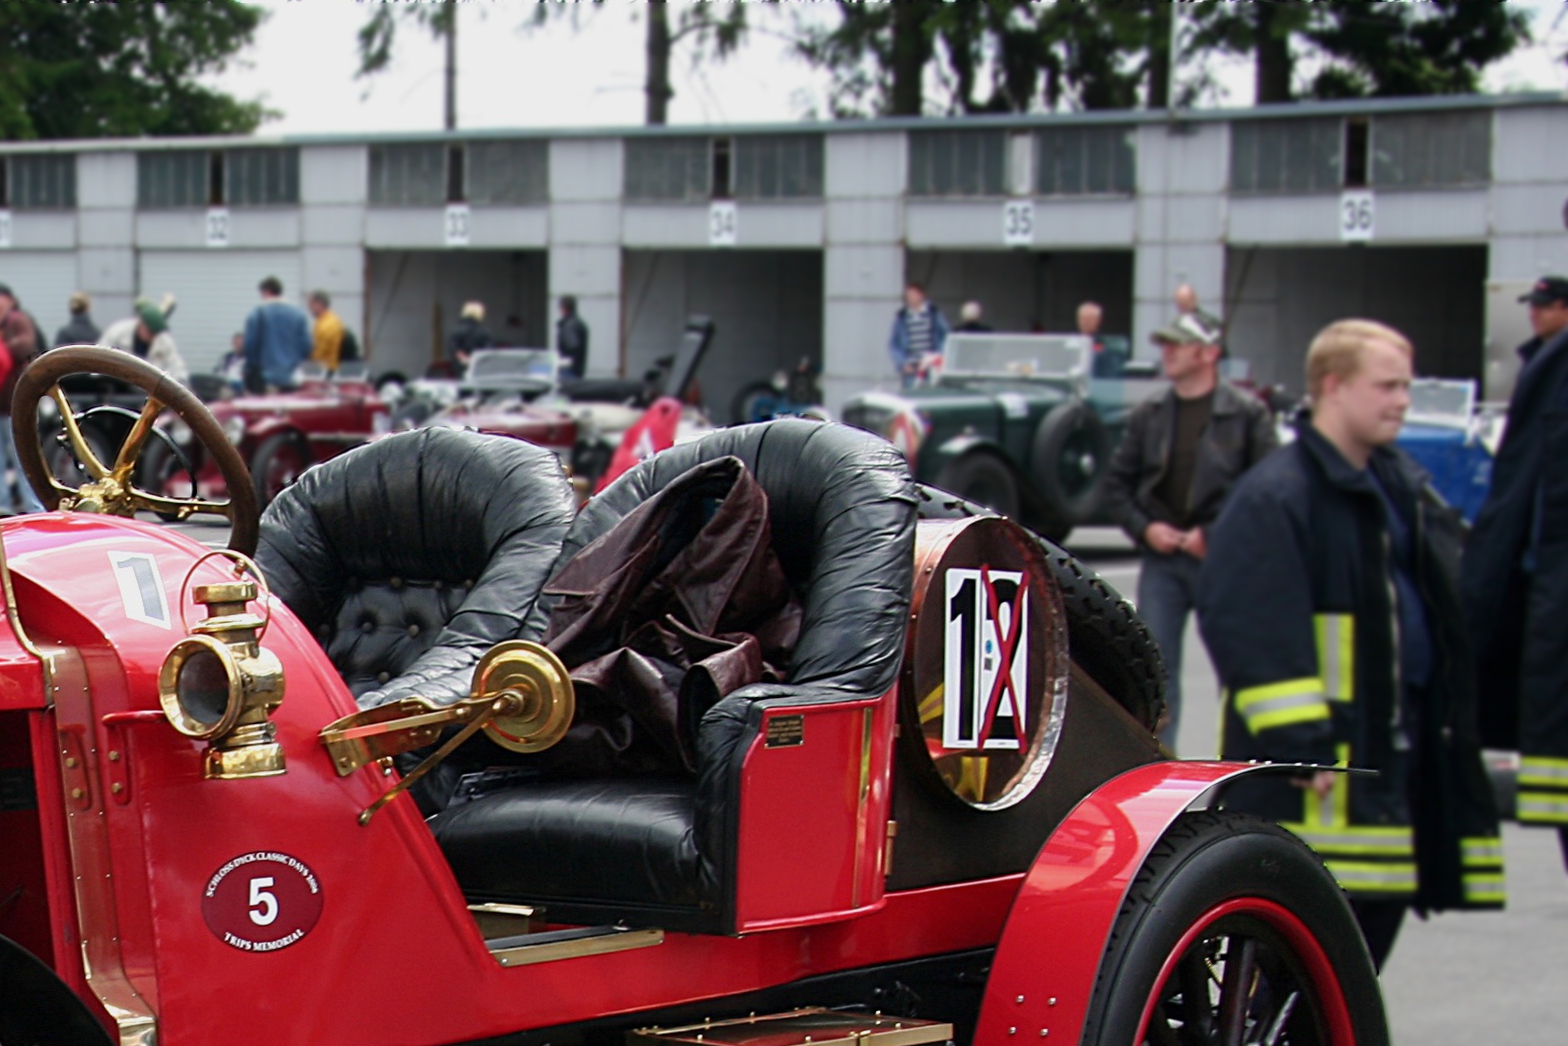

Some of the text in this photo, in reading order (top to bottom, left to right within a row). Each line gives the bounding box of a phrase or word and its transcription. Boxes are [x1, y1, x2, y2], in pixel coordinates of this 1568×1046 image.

[447, 211, 470, 238] 33
[712, 209, 734, 237] 34
[1006, 206, 1032, 235] 35
[1343, 199, 1373, 231] 36
[117, 557, 165, 622] 1
[288, 858, 309, 877] DAYS
[249, 876, 279, 926] 5
[224, 928, 305, 951] TRIPS MEMORIAL
